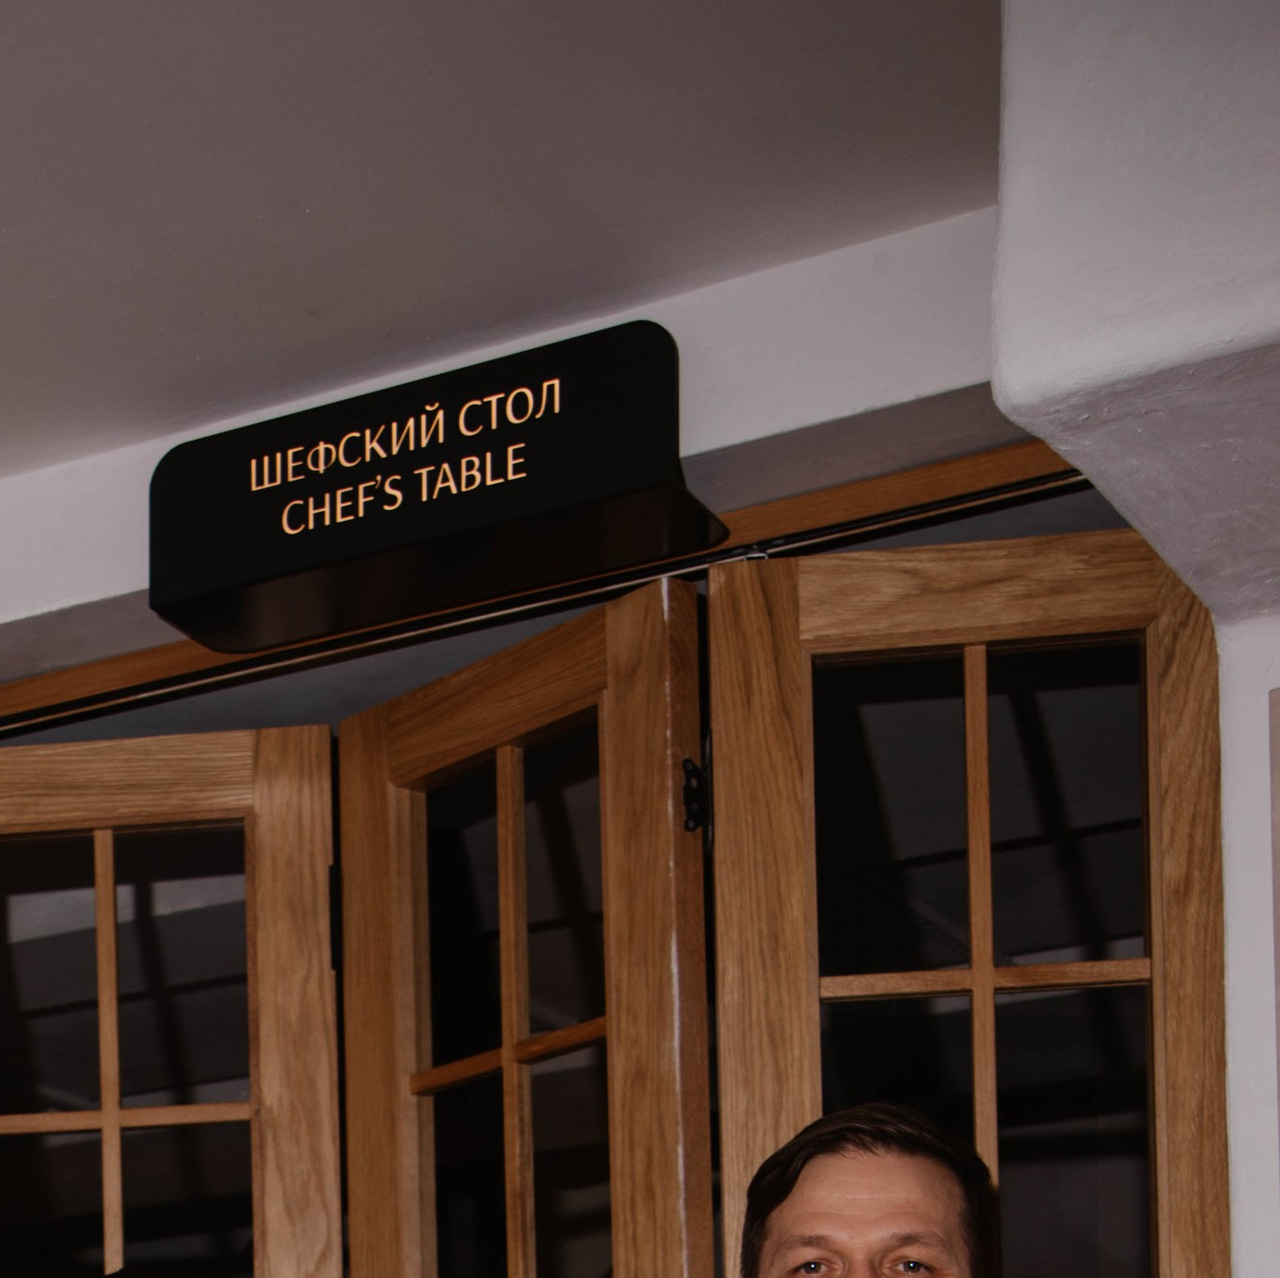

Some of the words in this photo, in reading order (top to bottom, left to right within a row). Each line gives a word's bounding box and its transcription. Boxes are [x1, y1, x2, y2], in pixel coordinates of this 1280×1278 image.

[250, 402, 445, 492] ШЕФСКИЙ
[458, 378, 560, 437] СТОЛ
[281, 474, 403, 535] CHEF'S
[413, 442, 527, 502] TABLE
